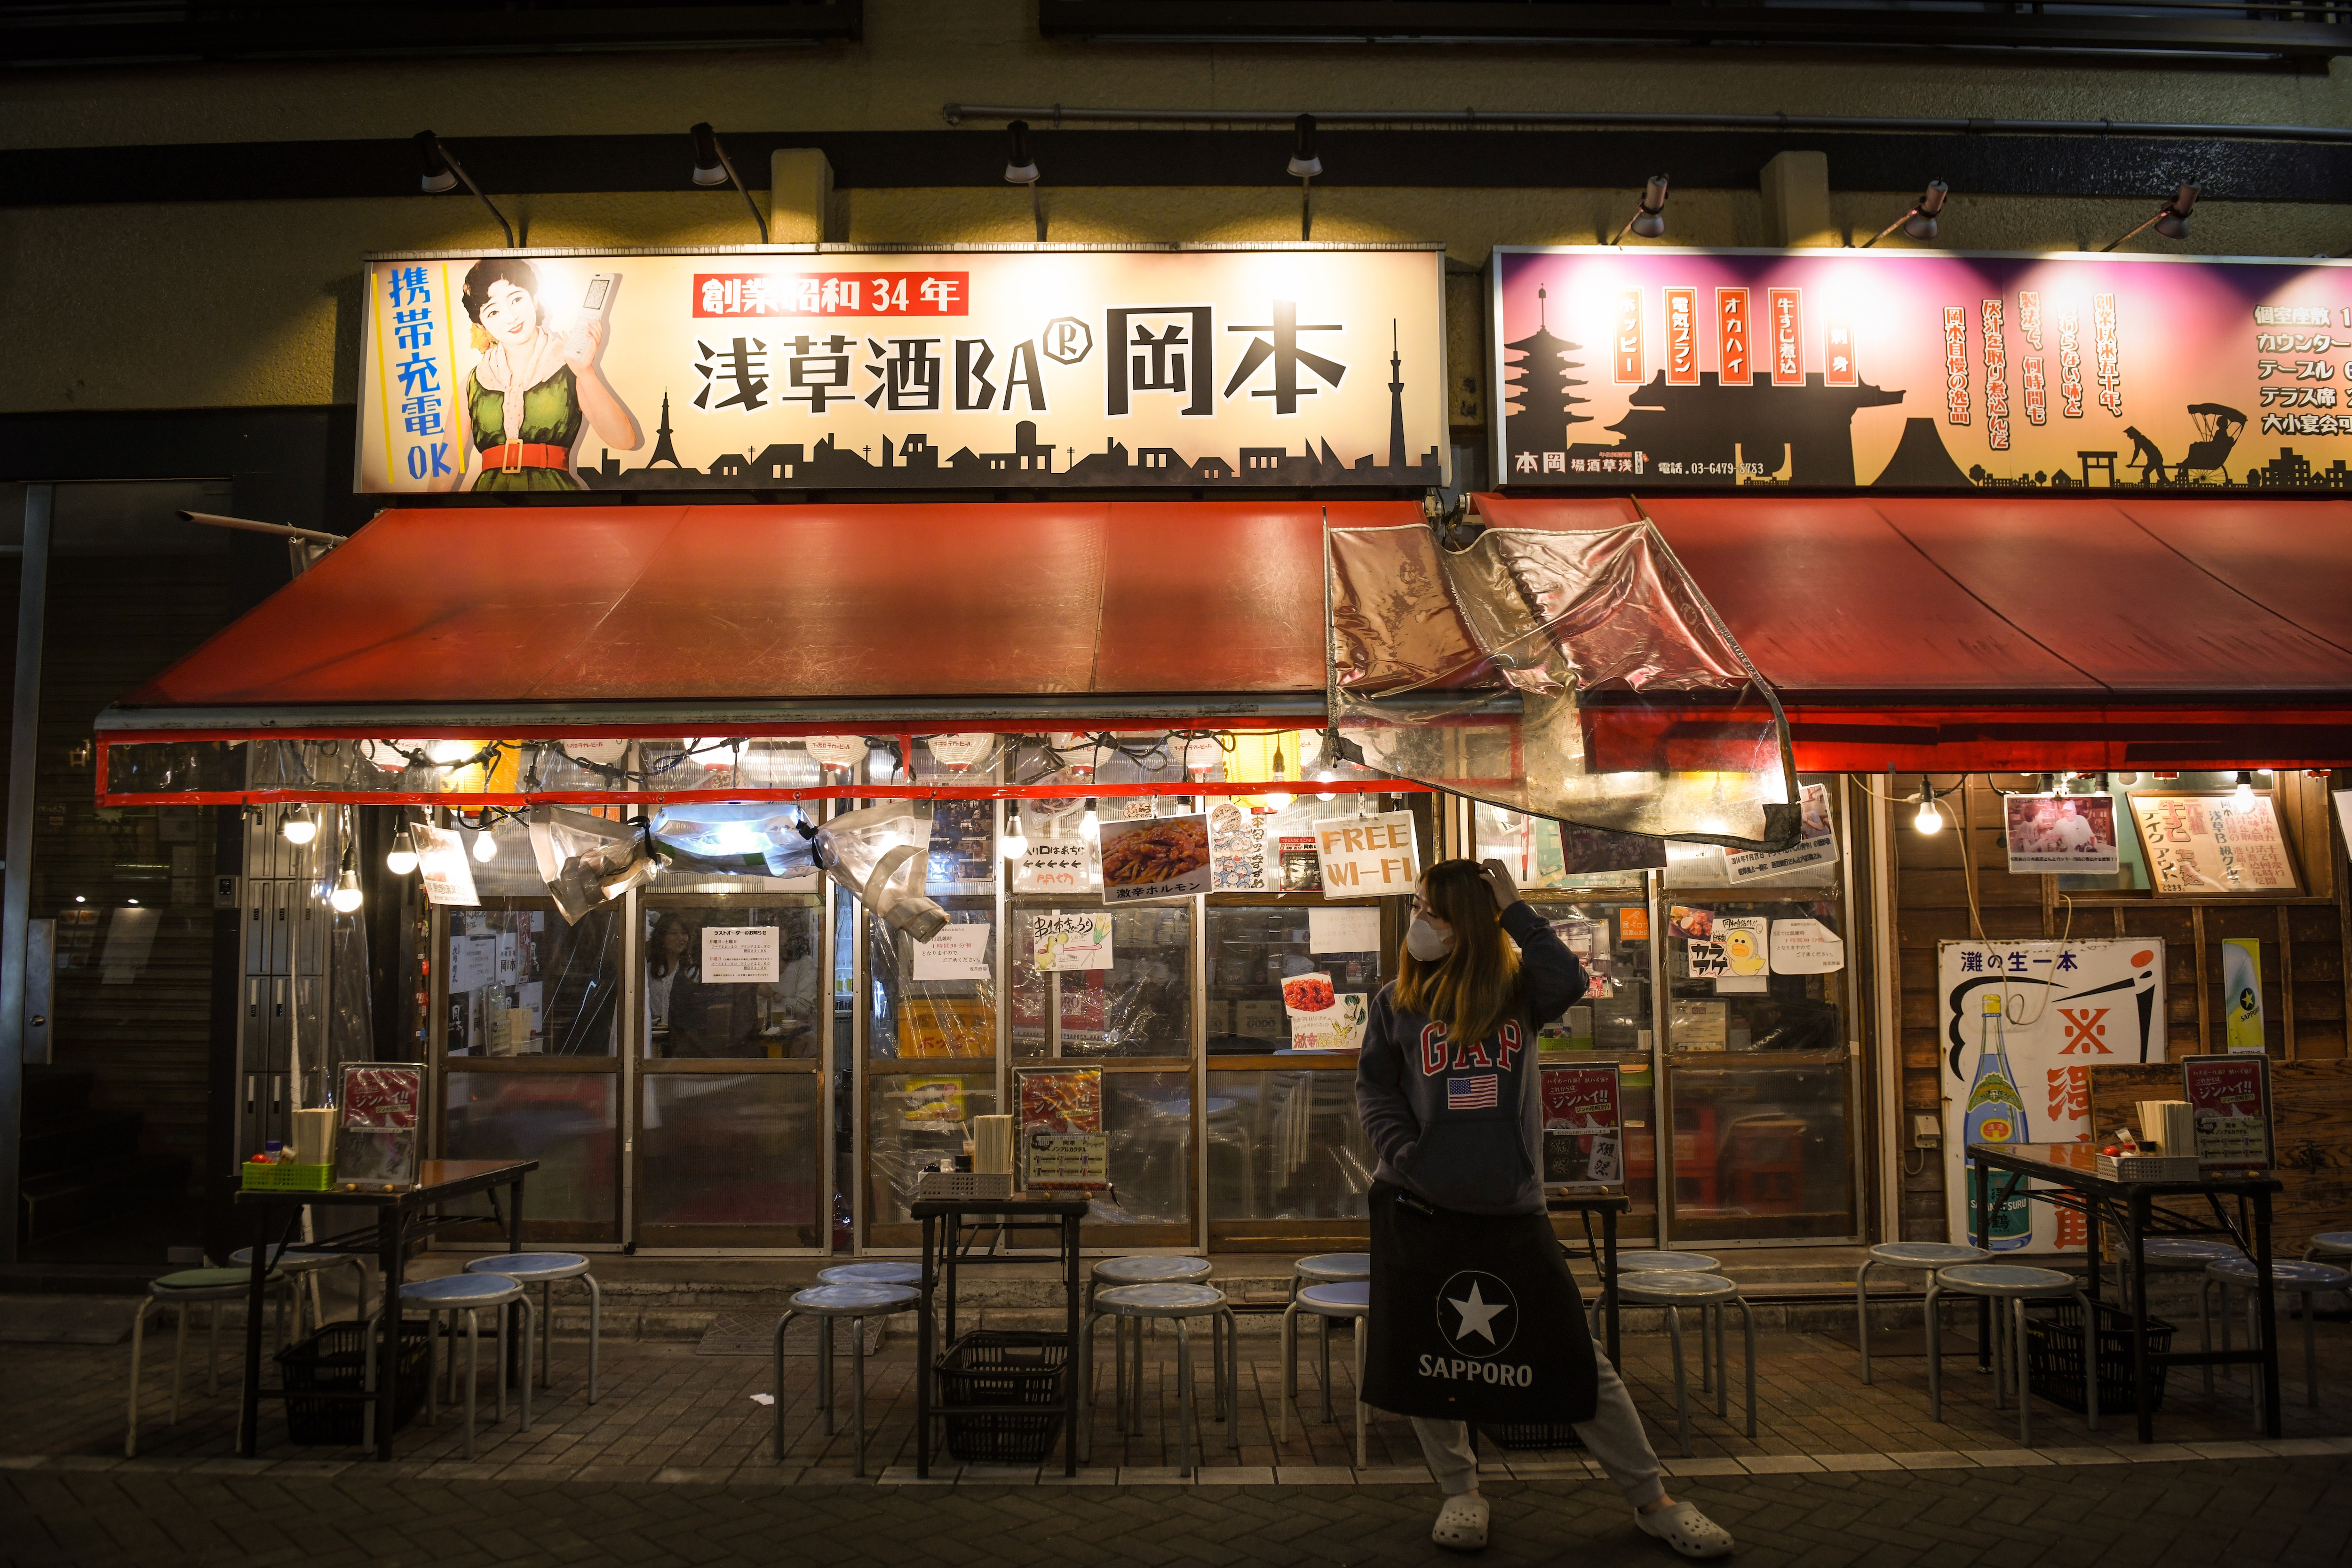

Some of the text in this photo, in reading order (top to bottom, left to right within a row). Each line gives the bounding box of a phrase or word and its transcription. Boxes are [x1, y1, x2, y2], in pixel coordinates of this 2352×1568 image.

[2255, 305, 2330, 326] 個室座敷
[1620, 298, 1637, 371] ホッピー
[1672, 297, 1690, 372] 電気ブラン
[1725, 298, 1743, 373] オカハイ
[1778, 298, 1797, 374] 牛すじ煮込
[2257, 333, 2350, 353] カウンター
[1944, 307, 1970, 425] 岡本自慢の逸品
[1982, 300, 2009, 449] 灰汁を取り煮込んだ
[2258, 360, 2334, 380] テーブル
[2260, 387, 2336, 408] テラス席
[1321, 823, 1409, 855] FREE
[1327, 856, 1412, 886] WI-FI
[1117, 882, 1200, 899] 激辛ホルモン
[1960, 950, 2079, 973] 灘の生一本
[2241, 1006, 2260, 1022] SAPPORO
[1421, 1020, 1522, 1076] GAP
[356, 1091, 409, 1108] ジンハイ!!
[1553, 1090, 1608, 1109] ジンハイ!!
[2199, 1081, 2252, 1100] ジンハイ!!
[1034, 1094, 1090, 1114] ジンハイ!!
[1419, 1354, 1533, 1387] SAPPORO
